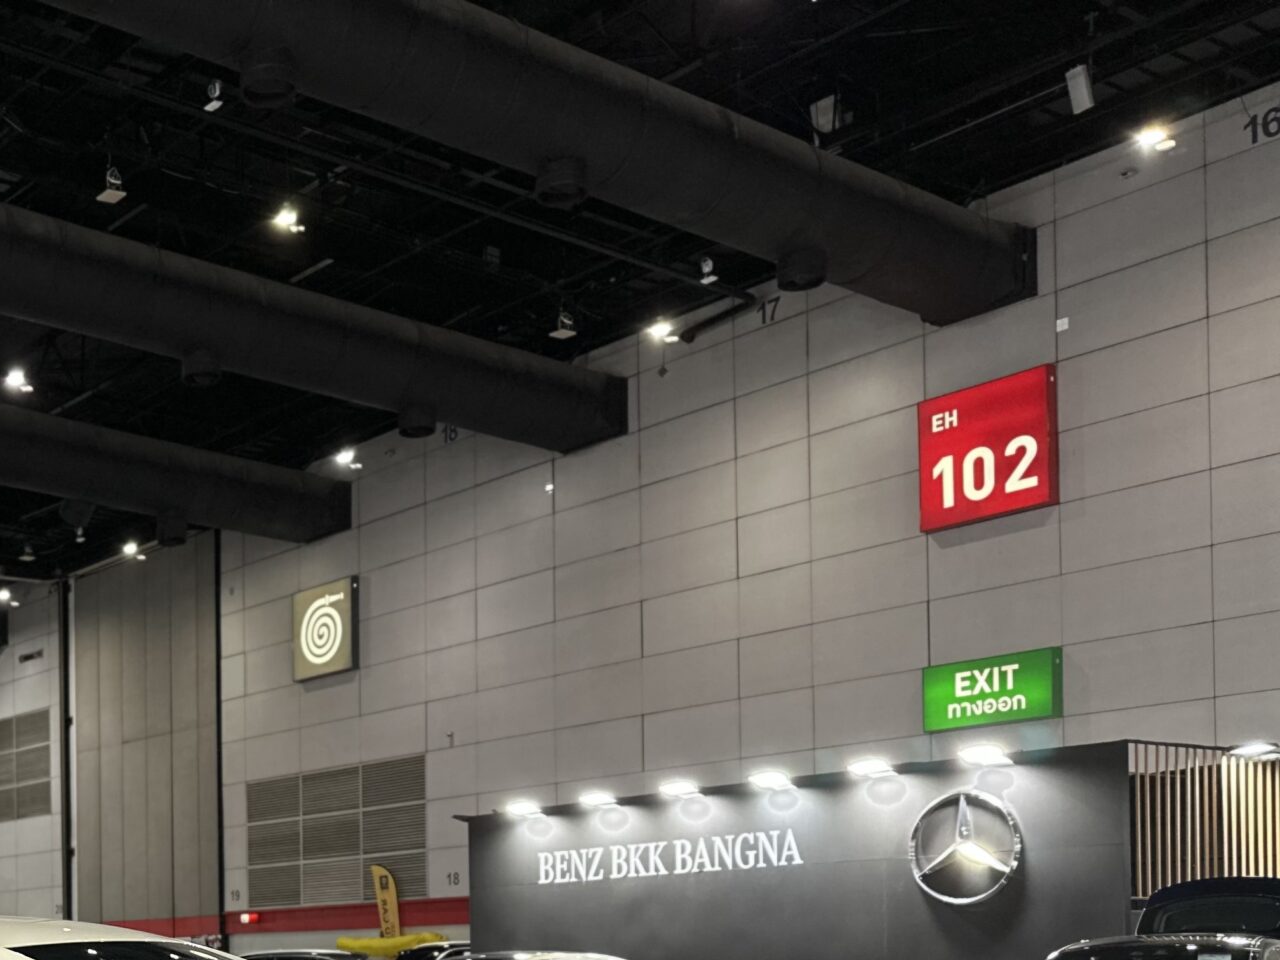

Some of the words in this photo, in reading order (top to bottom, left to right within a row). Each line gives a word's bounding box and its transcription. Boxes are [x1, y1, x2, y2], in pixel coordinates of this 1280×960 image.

[756, 295, 781, 324] 17
[931, 408, 958, 433] EH
[932, 434, 1039, 509] 102
[955, 663, 1020, 698] EXIT
[947, 694, 1027, 719] ทางออก
[538, 847, 604, 884] BENZ
[609, 841, 669, 879] BKK
[673, 828, 804, 874] BANGNA
[447, 871, 460, 886] 18
[230, 889, 240, 902] 19
